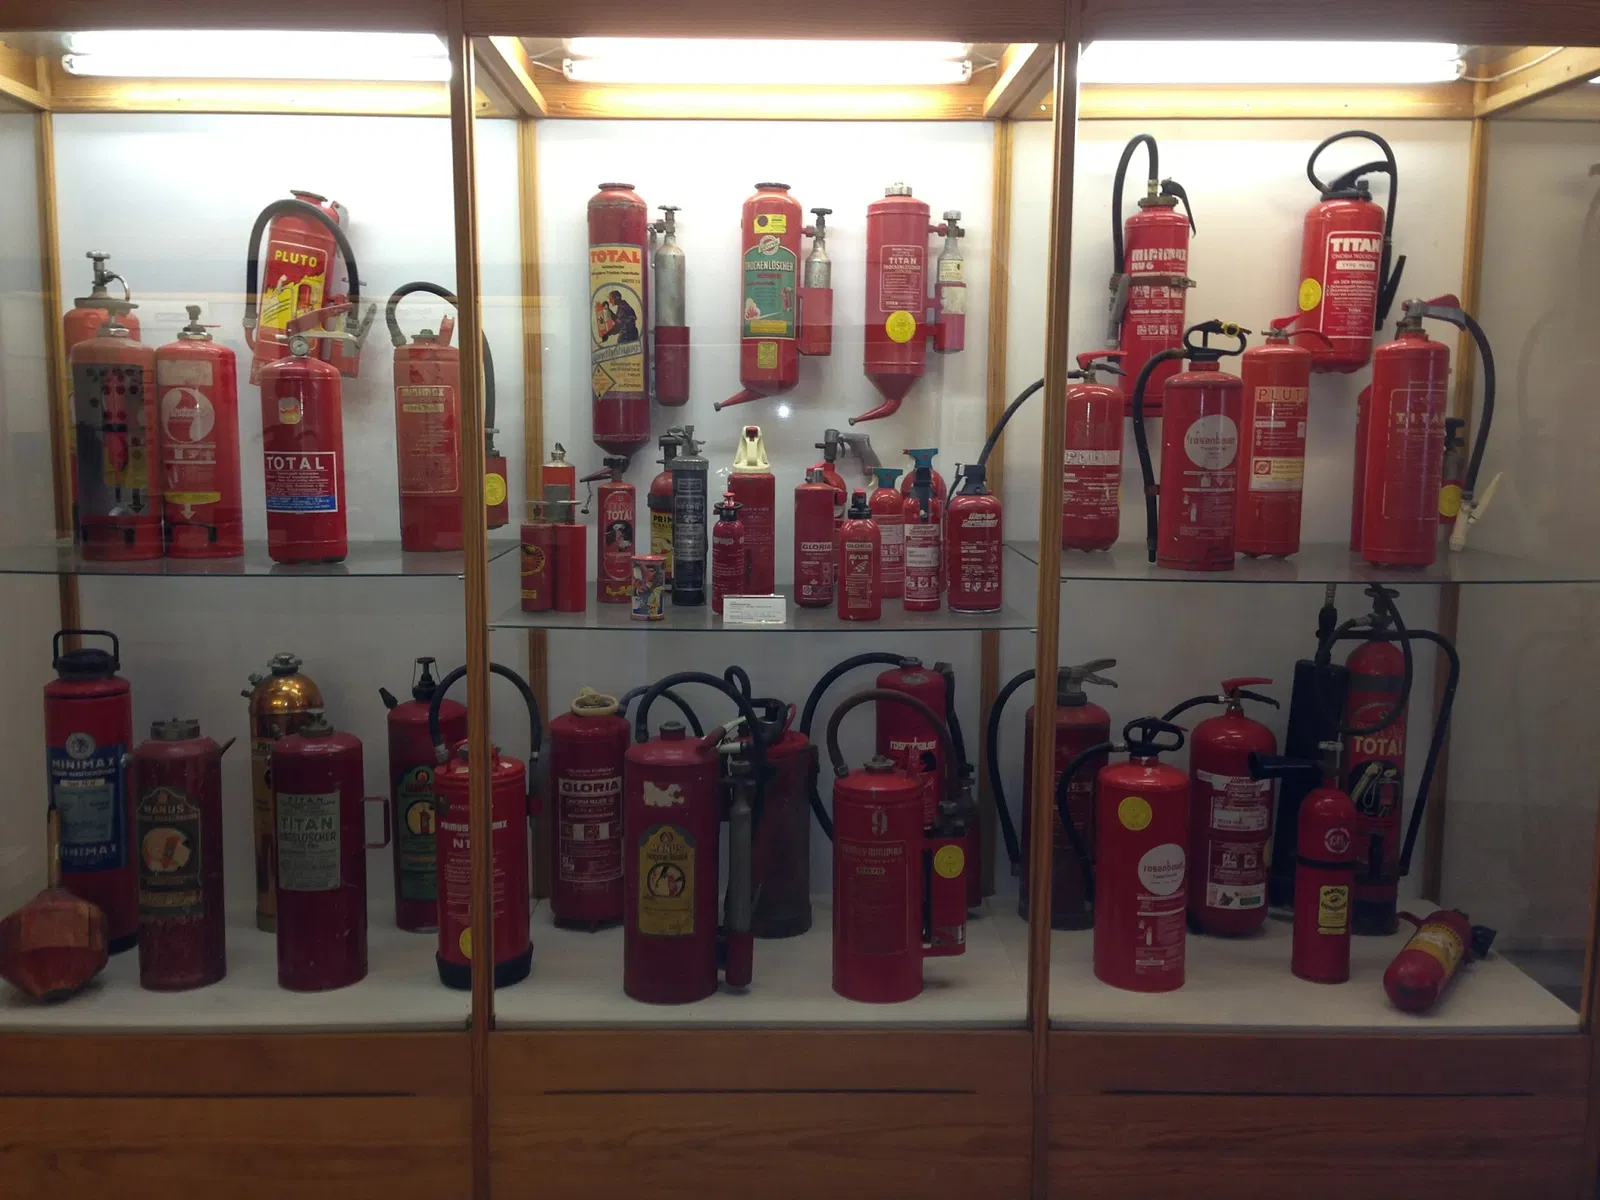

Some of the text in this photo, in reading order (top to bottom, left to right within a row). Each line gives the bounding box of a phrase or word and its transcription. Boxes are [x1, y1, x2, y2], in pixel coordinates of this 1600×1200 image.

[1330, 238, 1381, 253] TITAN
[274, 249, 317, 267] PLUTO
[590, 250, 640, 264] TOTAL
[888, 257, 917, 265] TITAN
[267, 456, 325, 470] TOTAL
[607, 510, 633, 520] TOTAL
[52, 757, 115, 770] MINIMAX
[562, 781, 620, 793] GLORIA
[281, 816, 333, 830] TITAN
